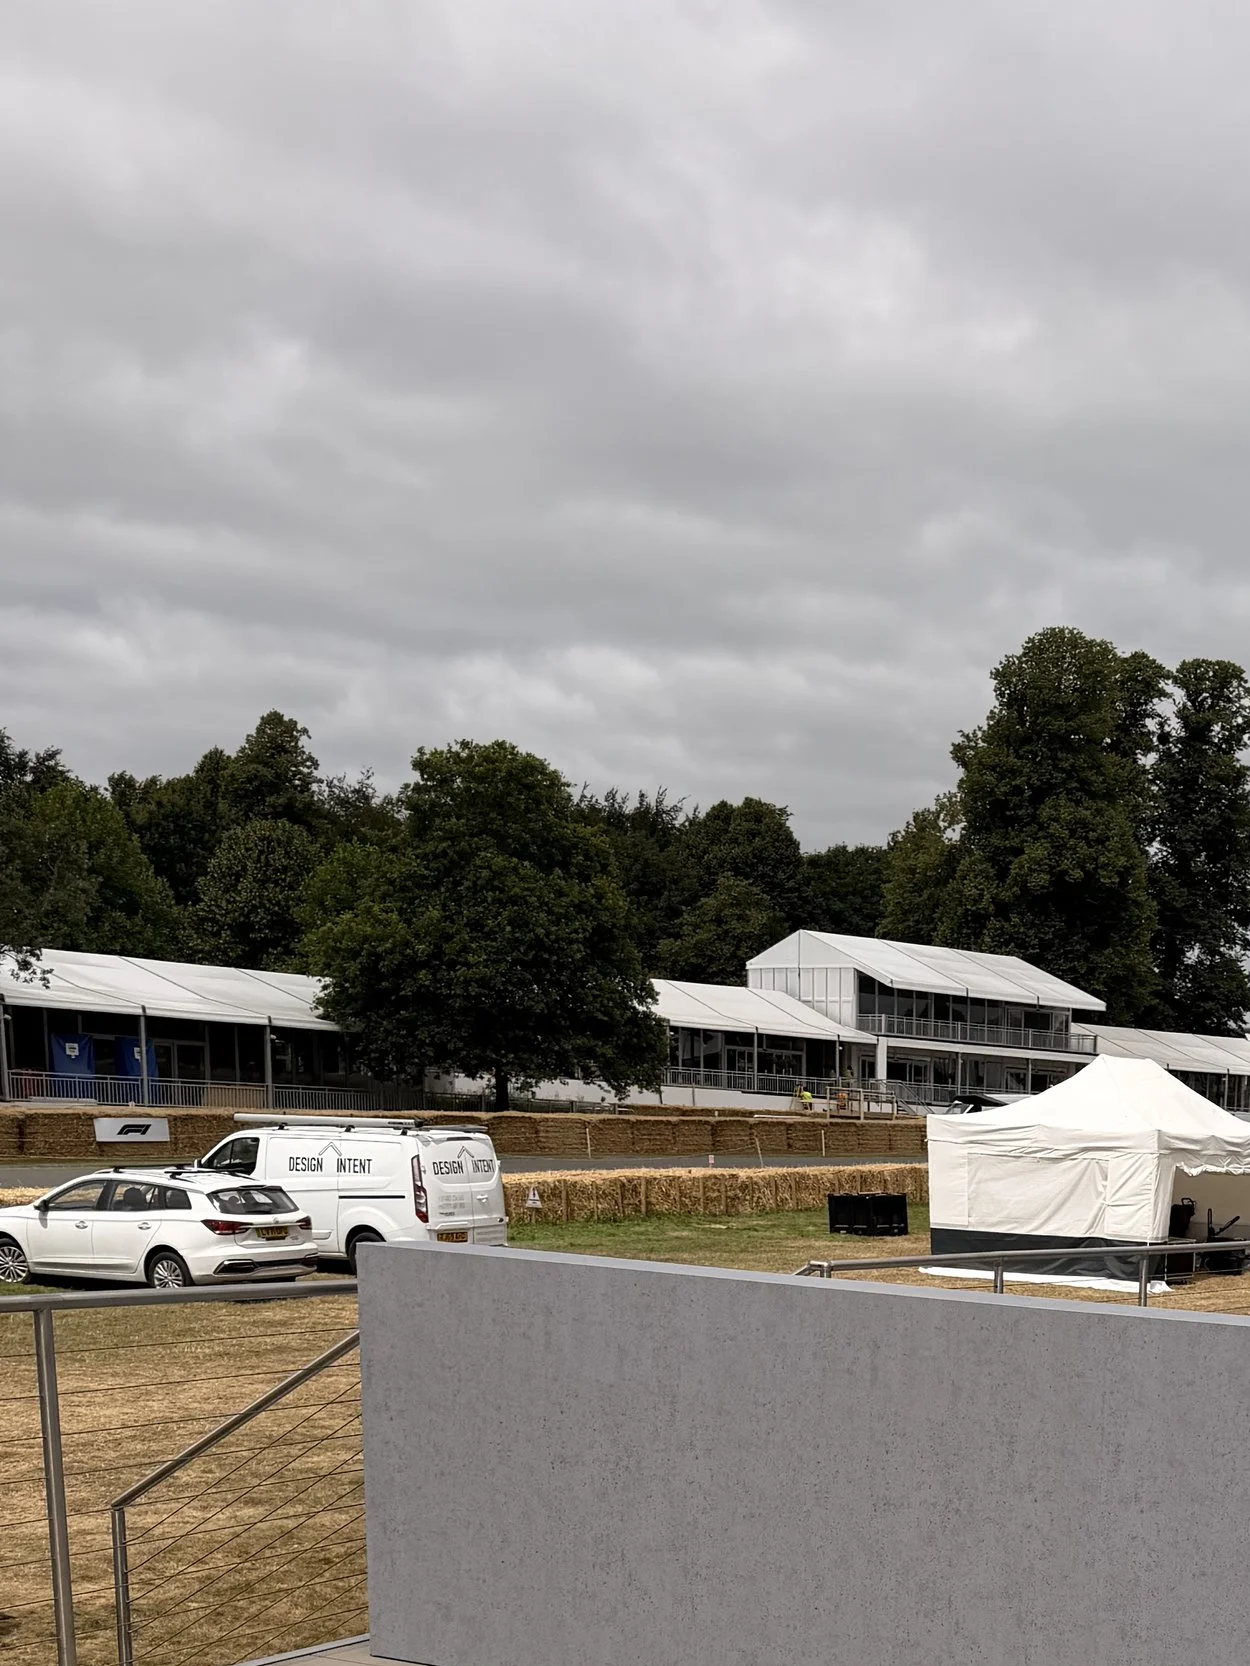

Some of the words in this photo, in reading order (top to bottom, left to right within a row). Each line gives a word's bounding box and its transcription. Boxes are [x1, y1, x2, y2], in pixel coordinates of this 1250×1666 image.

[289, 1156, 323, 1173] DESIGN
[336, 1158, 373, 1174] INTENT
[432, 1160, 464, 1175] DESIGN
[471, 1159, 495, 1173] INTENT
